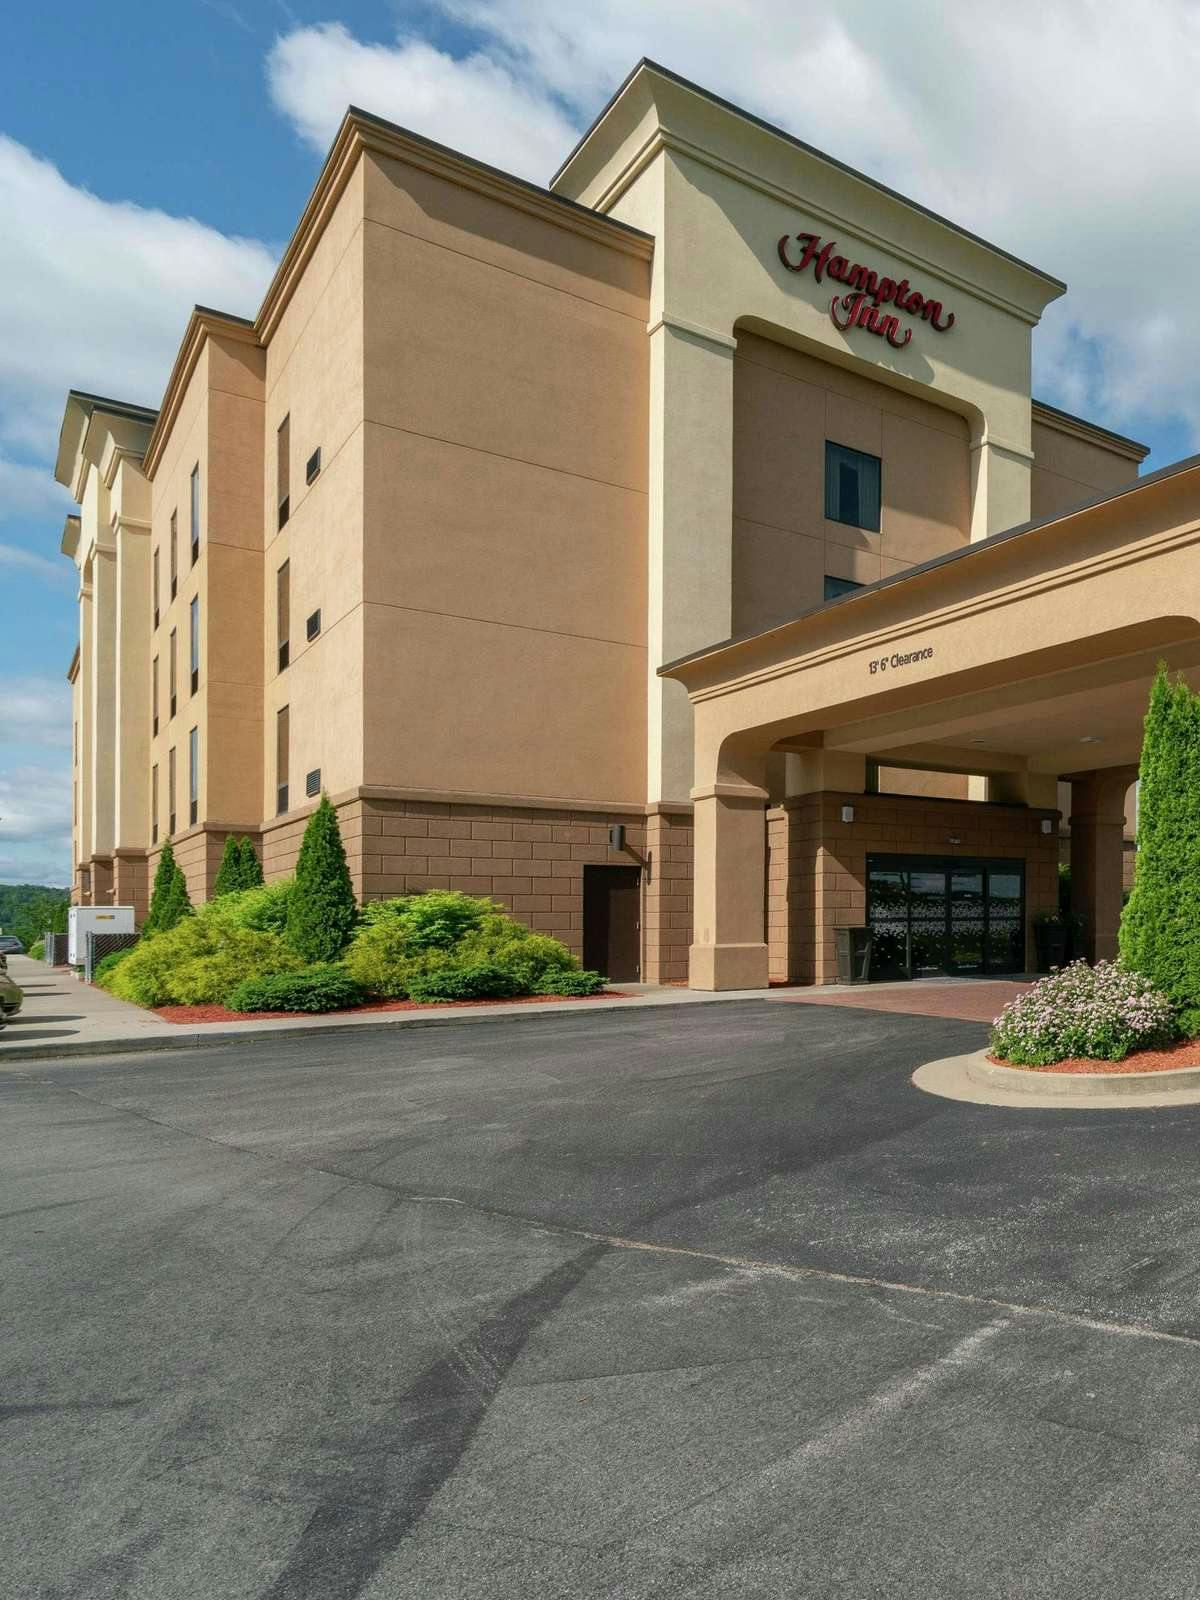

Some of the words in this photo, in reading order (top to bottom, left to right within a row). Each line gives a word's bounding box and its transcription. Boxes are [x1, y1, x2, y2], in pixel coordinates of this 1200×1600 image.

[778, 232, 955, 332] Hampton
[831, 292, 912, 348] Inn
[890, 647, 933, 668] Clearance
